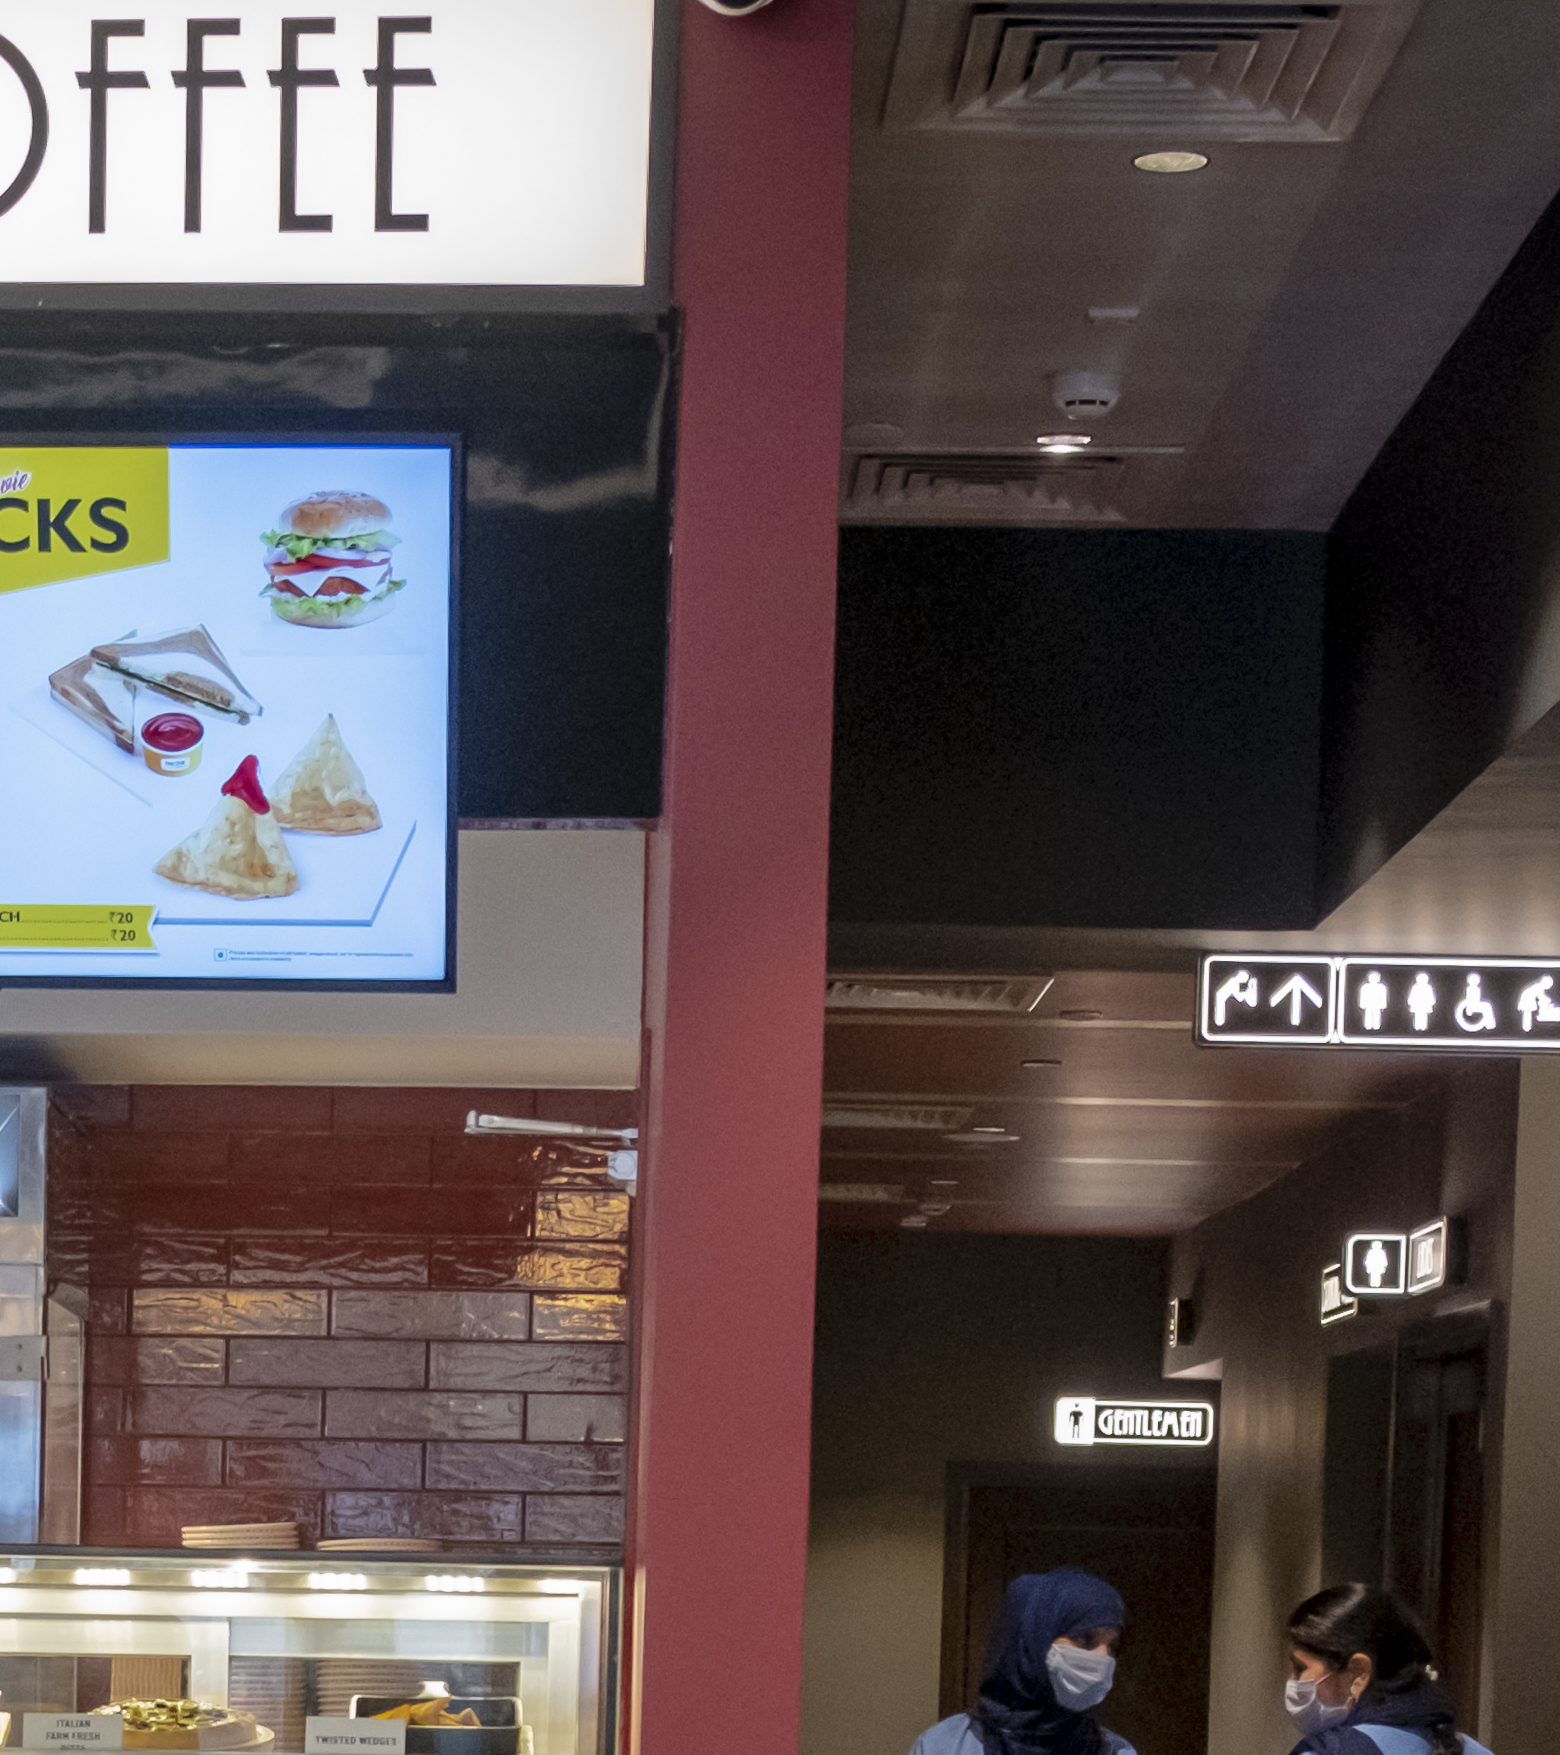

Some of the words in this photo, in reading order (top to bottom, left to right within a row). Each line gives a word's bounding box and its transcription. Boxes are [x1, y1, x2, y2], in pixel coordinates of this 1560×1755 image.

[1097, 1408, 1203, 1438] GENTLEMEN
[56, 1719, 91, 1729] ITALIAN
[315, 1735, 357, 1745] TWISTED
[359, 1736, 397, 1746] WEDGES
